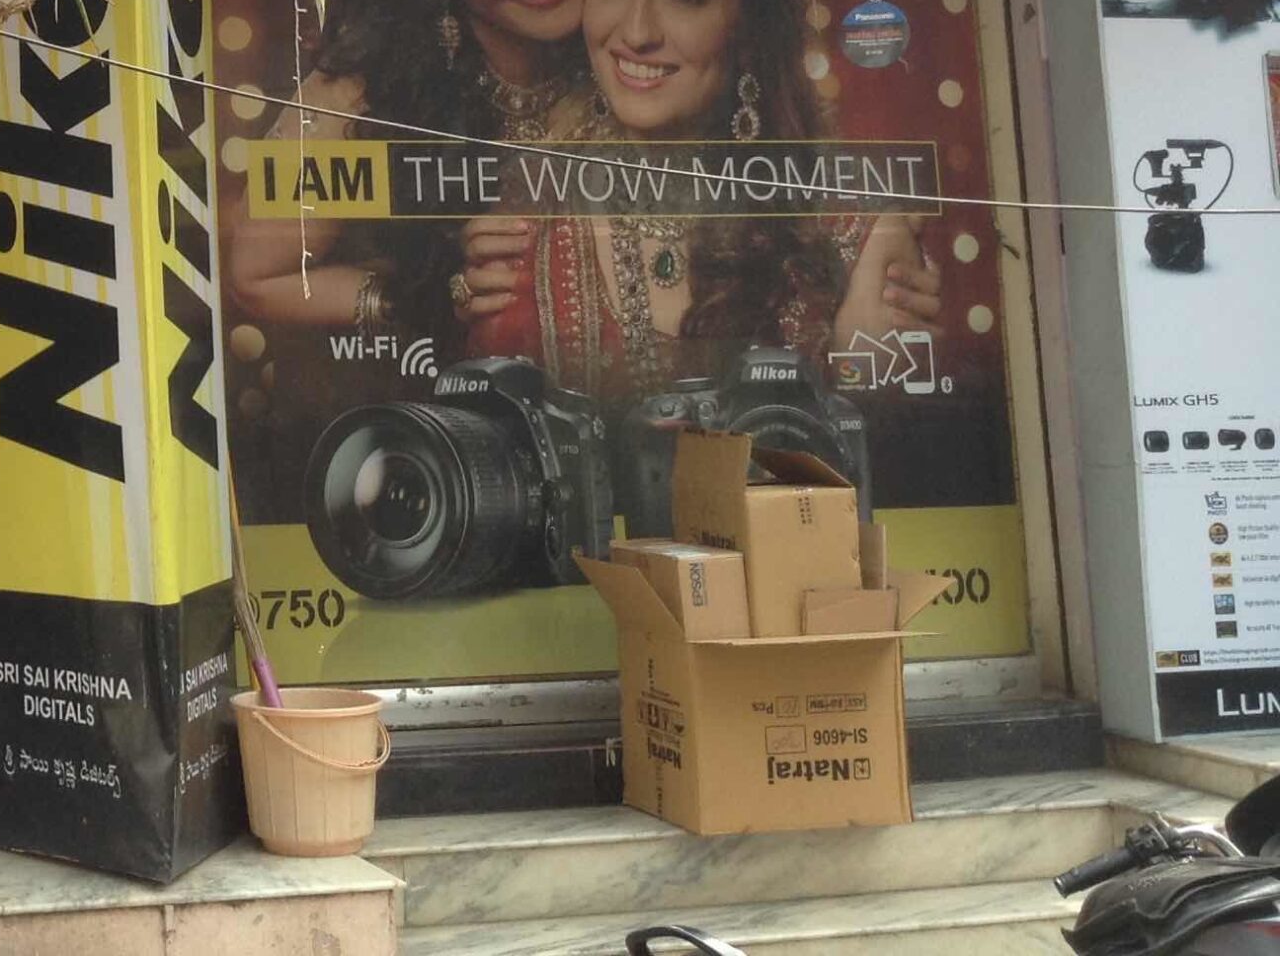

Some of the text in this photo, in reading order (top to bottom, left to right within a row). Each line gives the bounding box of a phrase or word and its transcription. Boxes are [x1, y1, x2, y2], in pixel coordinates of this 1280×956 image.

[263, 155, 925, 204] I AM THE WOW MOMENT
[329, 335, 398, 360] Wi-Fi
[440, 377, 490, 394] Nikon
[750, 366, 798, 381] Nikon
[1182, 393, 1220, 407] GH5
[691, 562, 704, 607] EPSON
[22, 664, 50, 689] SAI
[53, 669, 132, 701] KRISHNA
[23, 694, 95, 727] DIGITALS
[186, 686, 218, 723] DIGITALS
[752, 701, 774, 715] Pcs
[813, 728, 868, 746] SI-4606
[766, 758, 850, 786] Natraj
